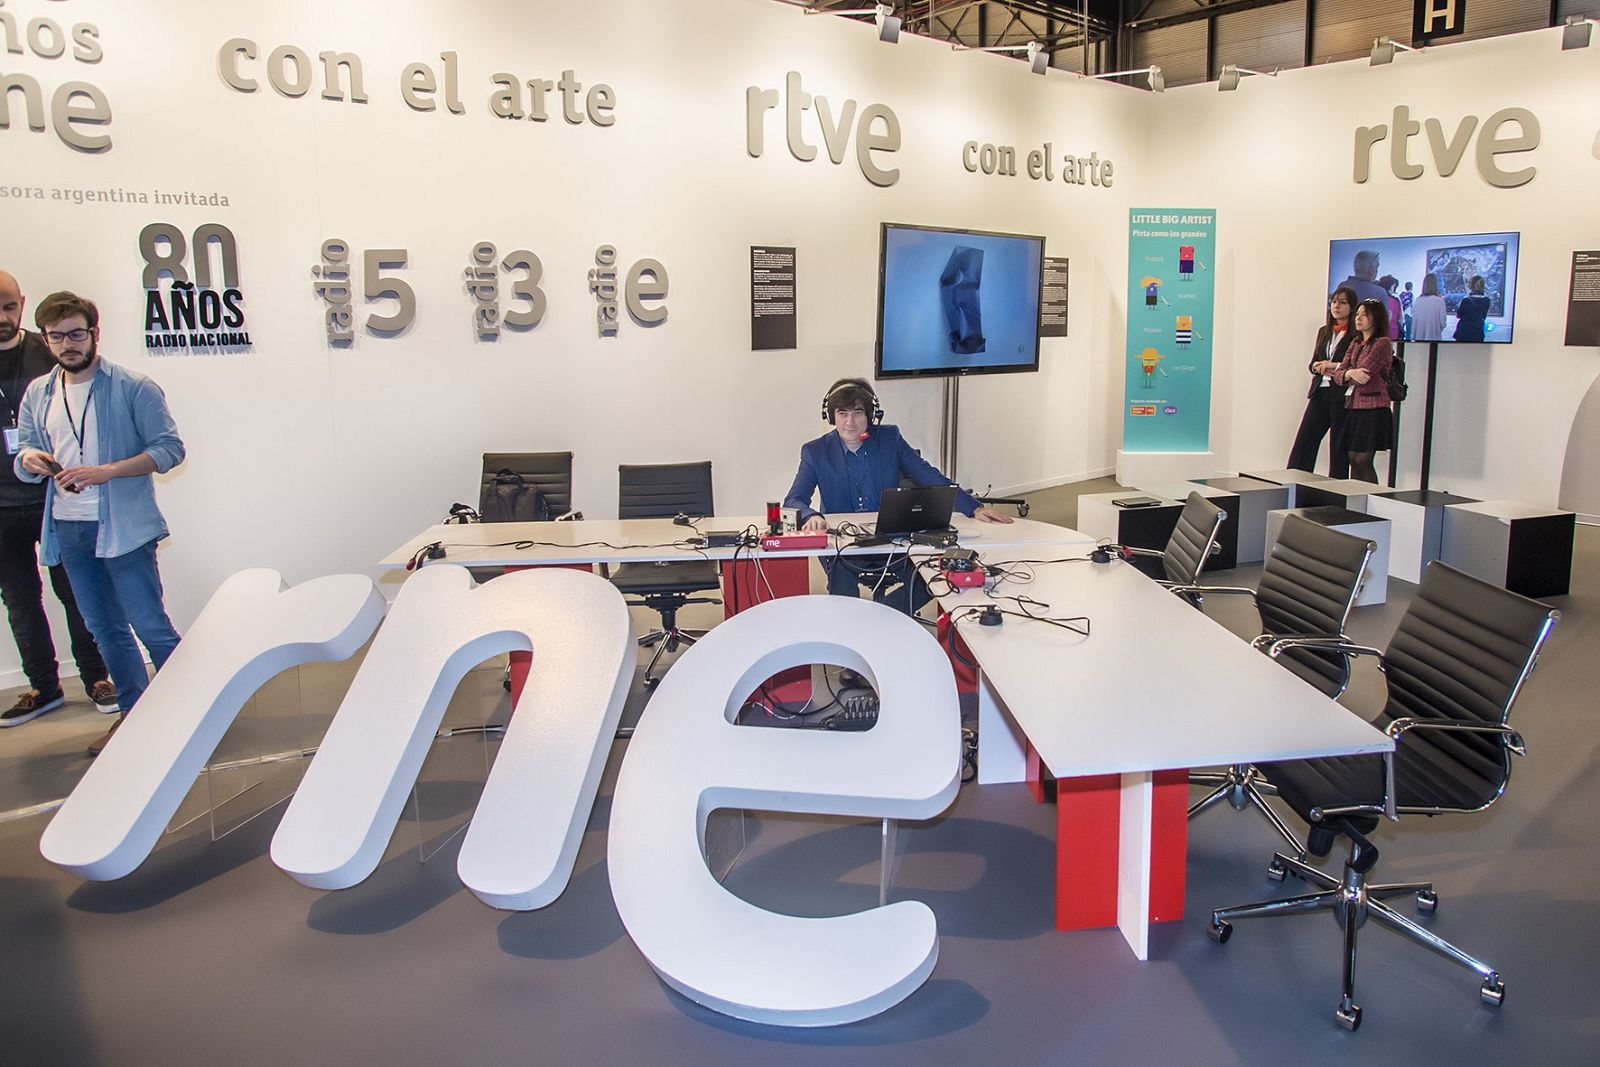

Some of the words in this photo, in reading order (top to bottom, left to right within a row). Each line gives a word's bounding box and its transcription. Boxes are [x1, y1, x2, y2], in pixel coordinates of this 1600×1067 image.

[1423, 0, 1456, 33] H
[218, 37, 368, 103] con
[400, 51, 466, 115] el
[489, 69, 616, 127] arte
[745, 70, 901, 188] rtve
[1353, 104, 1541, 189] rtve
[0, 186, 45, 199] sora
[51, 188, 149, 204] argentina
[154, 190, 230, 207] invitada
[962, 139, 1017, 176] con
[1027, 142, 1055, 182] el
[1063, 150, 1114, 188] arte
[1132, 214, 1160, 224] LITTLE
[1162, 215, 1178, 224] BIG
[1180, 215, 1213, 225] ARTIST
[1133, 229, 1150, 237] Pinta
[1169, 230, 1179, 238] los
[1180, 230, 1207, 239] grandes
[145, 280, 245, 331] AÑOS
[313, 238, 355, 344] radio
[363, 248, 417, 333] 5
[466, 240, 499, 343] radio
[499, 249, 547, 332] 3
[588, 243, 618, 339] radio
[624, 257, 669, 328] e
[145, 333, 187, 348] RADIO
[190, 332, 253, 347] NACIONAL
[39, 563, 963, 1029] rne
